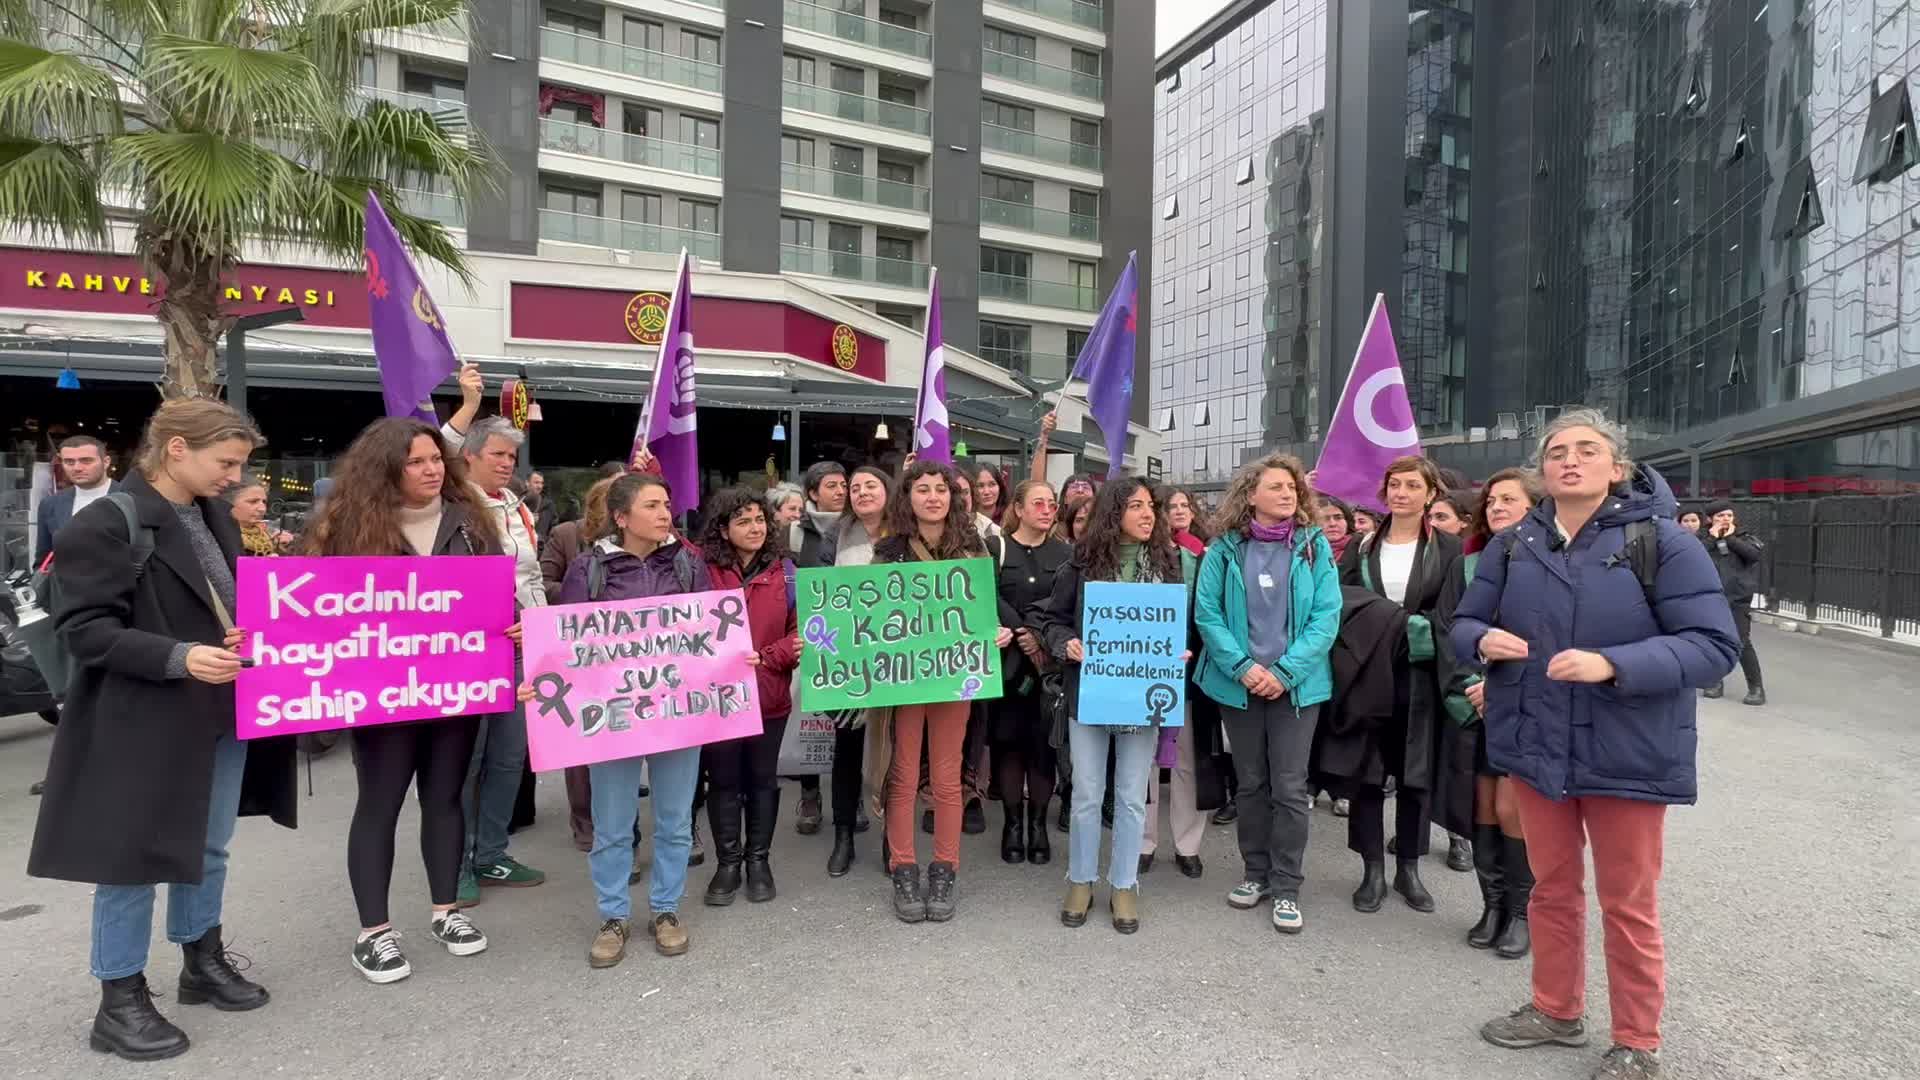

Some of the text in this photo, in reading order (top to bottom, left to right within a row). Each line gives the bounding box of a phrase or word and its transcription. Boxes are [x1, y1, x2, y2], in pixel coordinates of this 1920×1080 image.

[224, 285, 334, 305] NYASI
[267, 571, 463, 619] Kadınlar
[811, 566, 976, 612] yaşasın
[1087, 606, 1176, 624] yaşasın
[252, 622, 486, 677] hayatlarına
[566, 630, 716, 668] SAVUNMAK
[1085, 629, 1173, 657] feminist
[1084, 658, 1184, 680] mücadelemiz
[378, 666, 511, 714] çıkıyor
